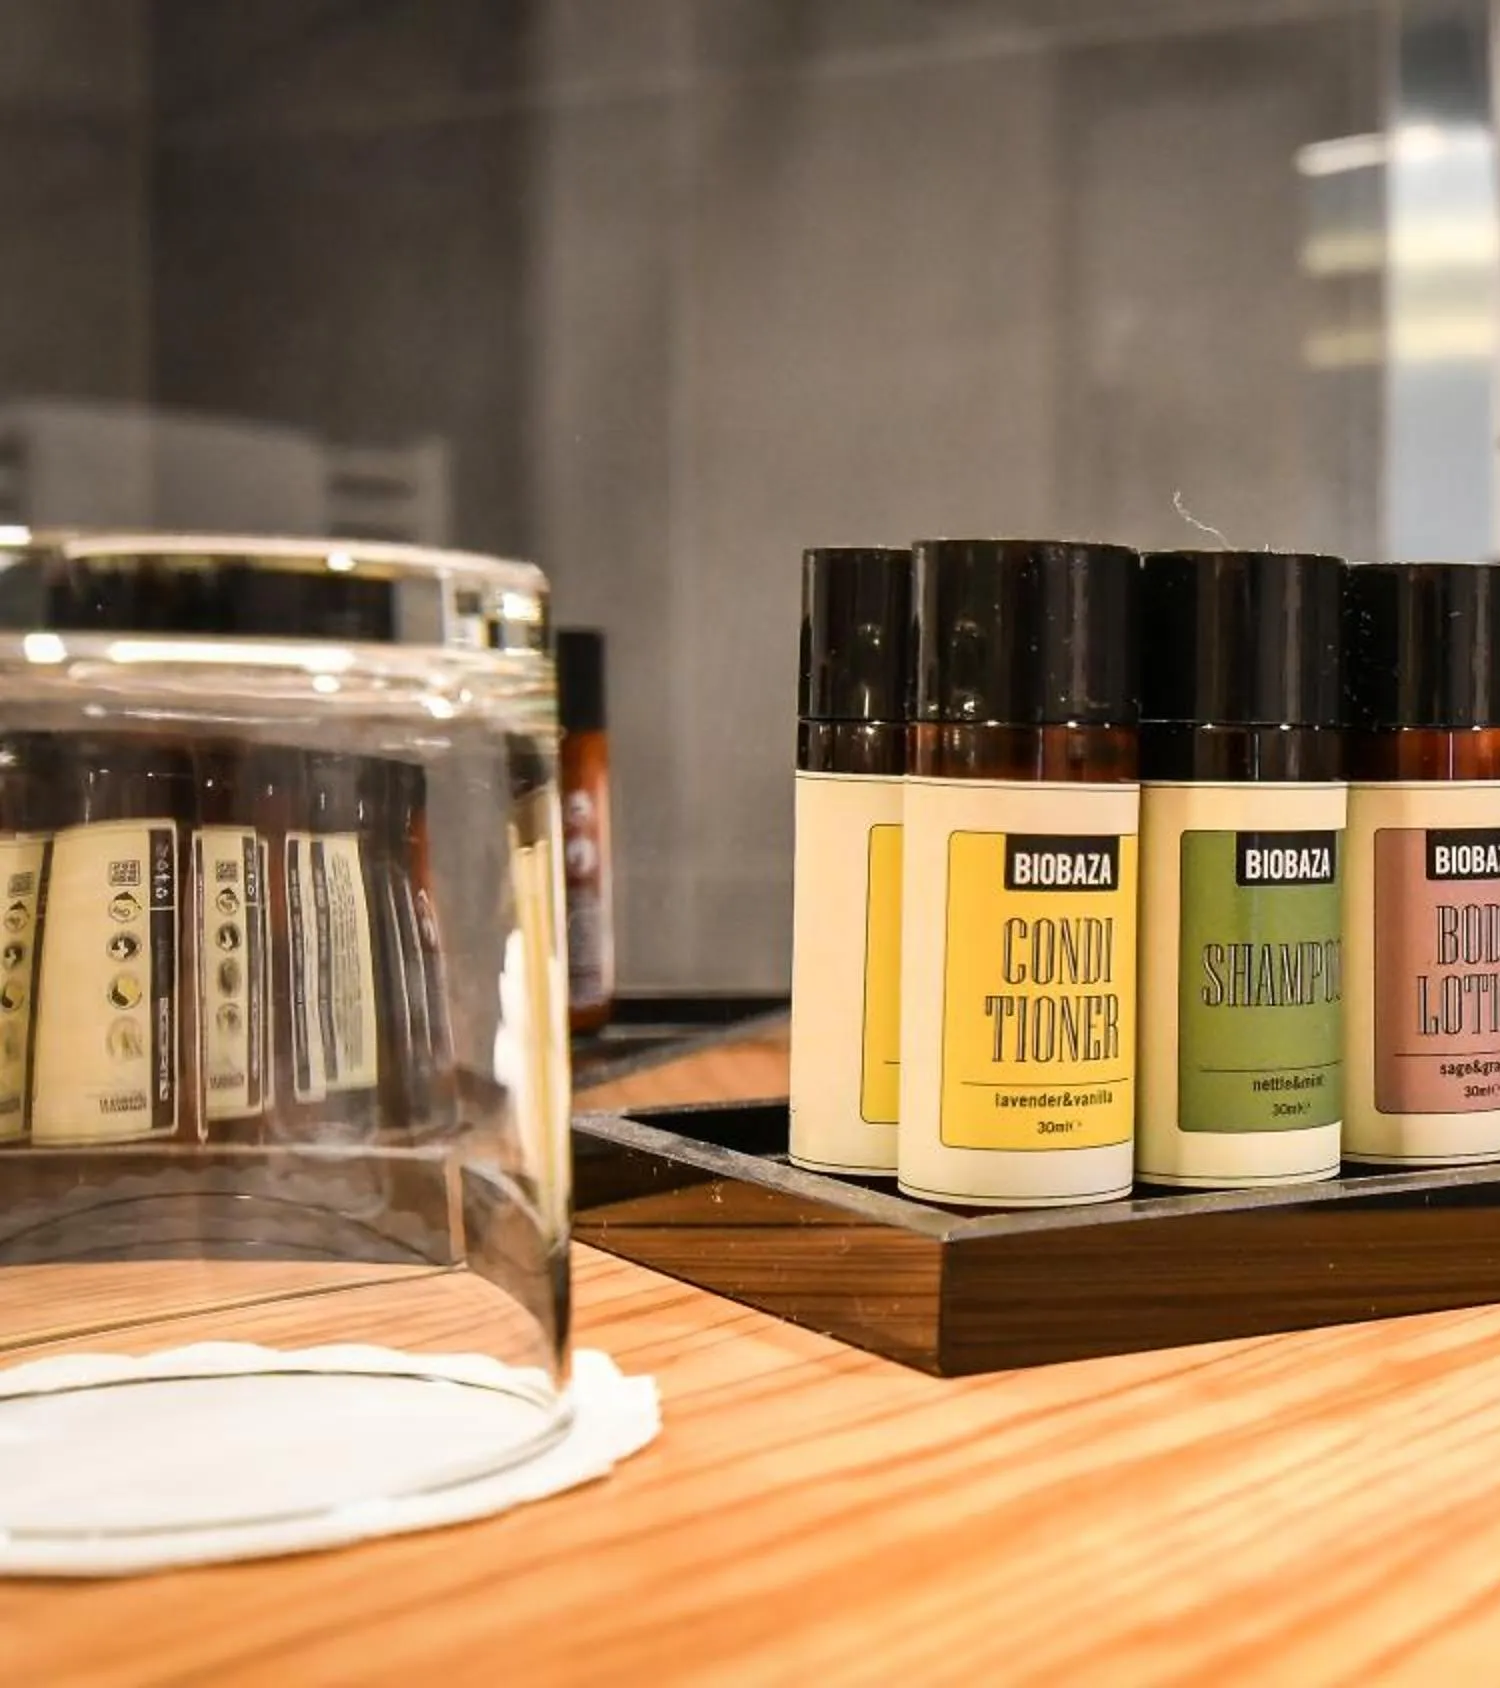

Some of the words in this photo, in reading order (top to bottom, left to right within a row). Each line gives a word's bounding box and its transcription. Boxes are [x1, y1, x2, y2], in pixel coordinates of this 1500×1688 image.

[1013, 851, 1112, 886] BIOBAZA
[1245, 848, 1330, 881] BIOBAZA
[1003, 917, 1114, 985] CONDI
[985, 994, 1119, 1064] TIONER
